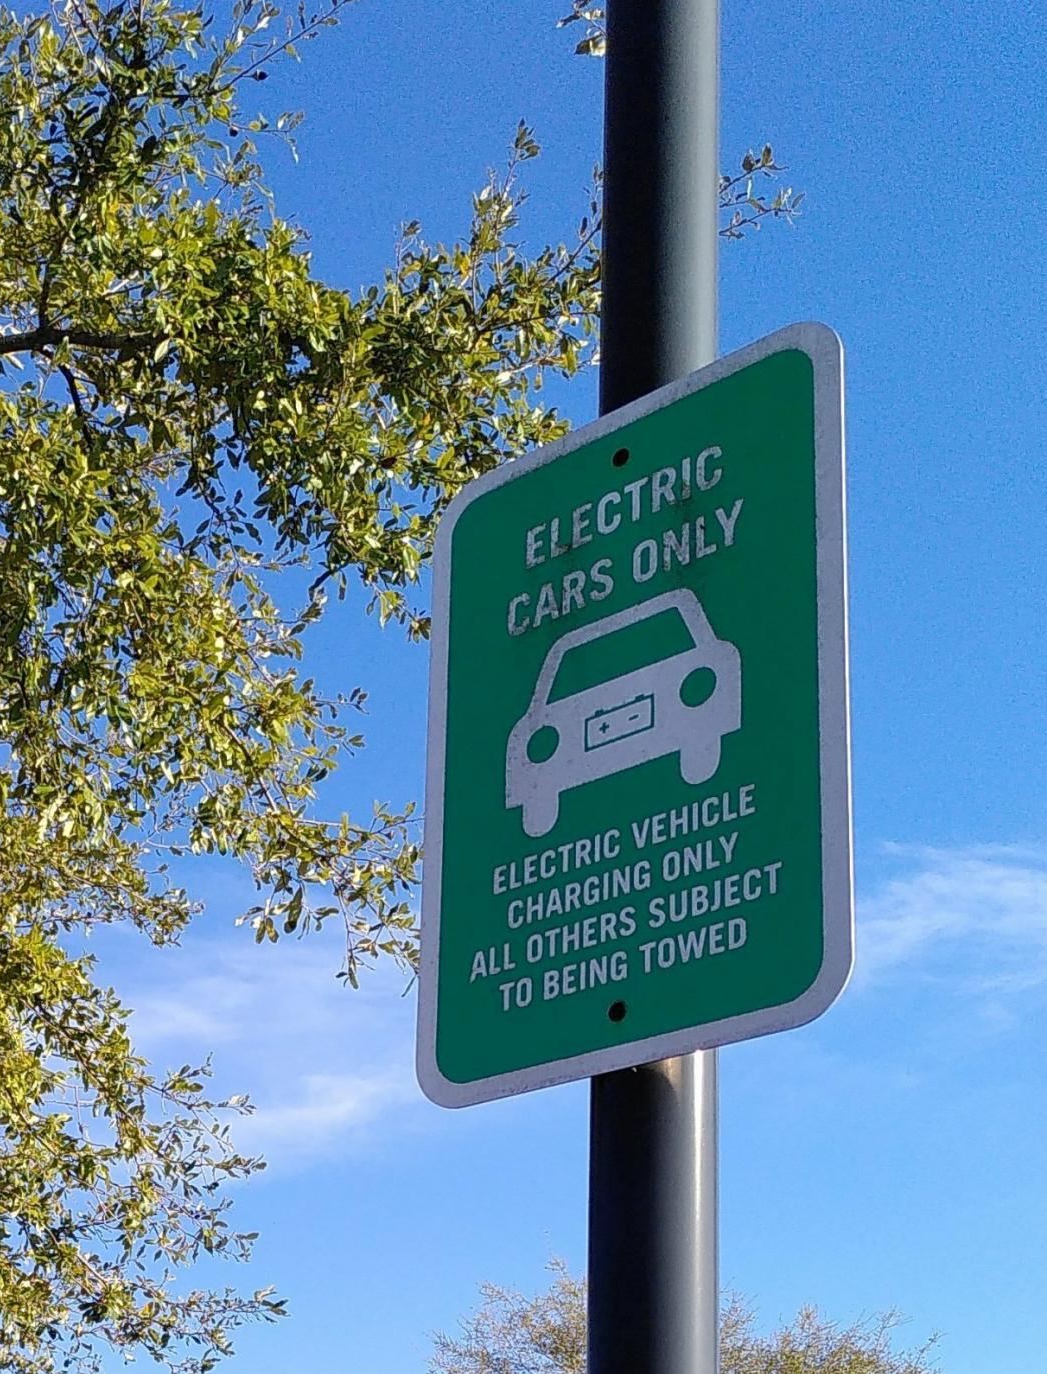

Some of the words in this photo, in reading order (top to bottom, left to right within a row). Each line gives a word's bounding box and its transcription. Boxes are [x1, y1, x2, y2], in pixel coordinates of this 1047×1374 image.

[525, 445, 723, 570] ELECTRIC
[506, 558, 614, 637] CARS
[632, 498, 744, 584] ONLY
[492, 829, 621, 895] ELECTRIC
[631, 783, 756, 849] VEHICLE
[507, 860, 652, 929] CHARGING
[662, 831, 739, 881] ONLY
[469, 943, 516, 983] ALL
[526, 906, 637, 963] OTHERS
[648, 861, 783, 928] SUBJECT
[499, 977, 533, 1011] TO
[543, 951, 628, 1001] BEING
[638, 918, 748, 974] TOWED
